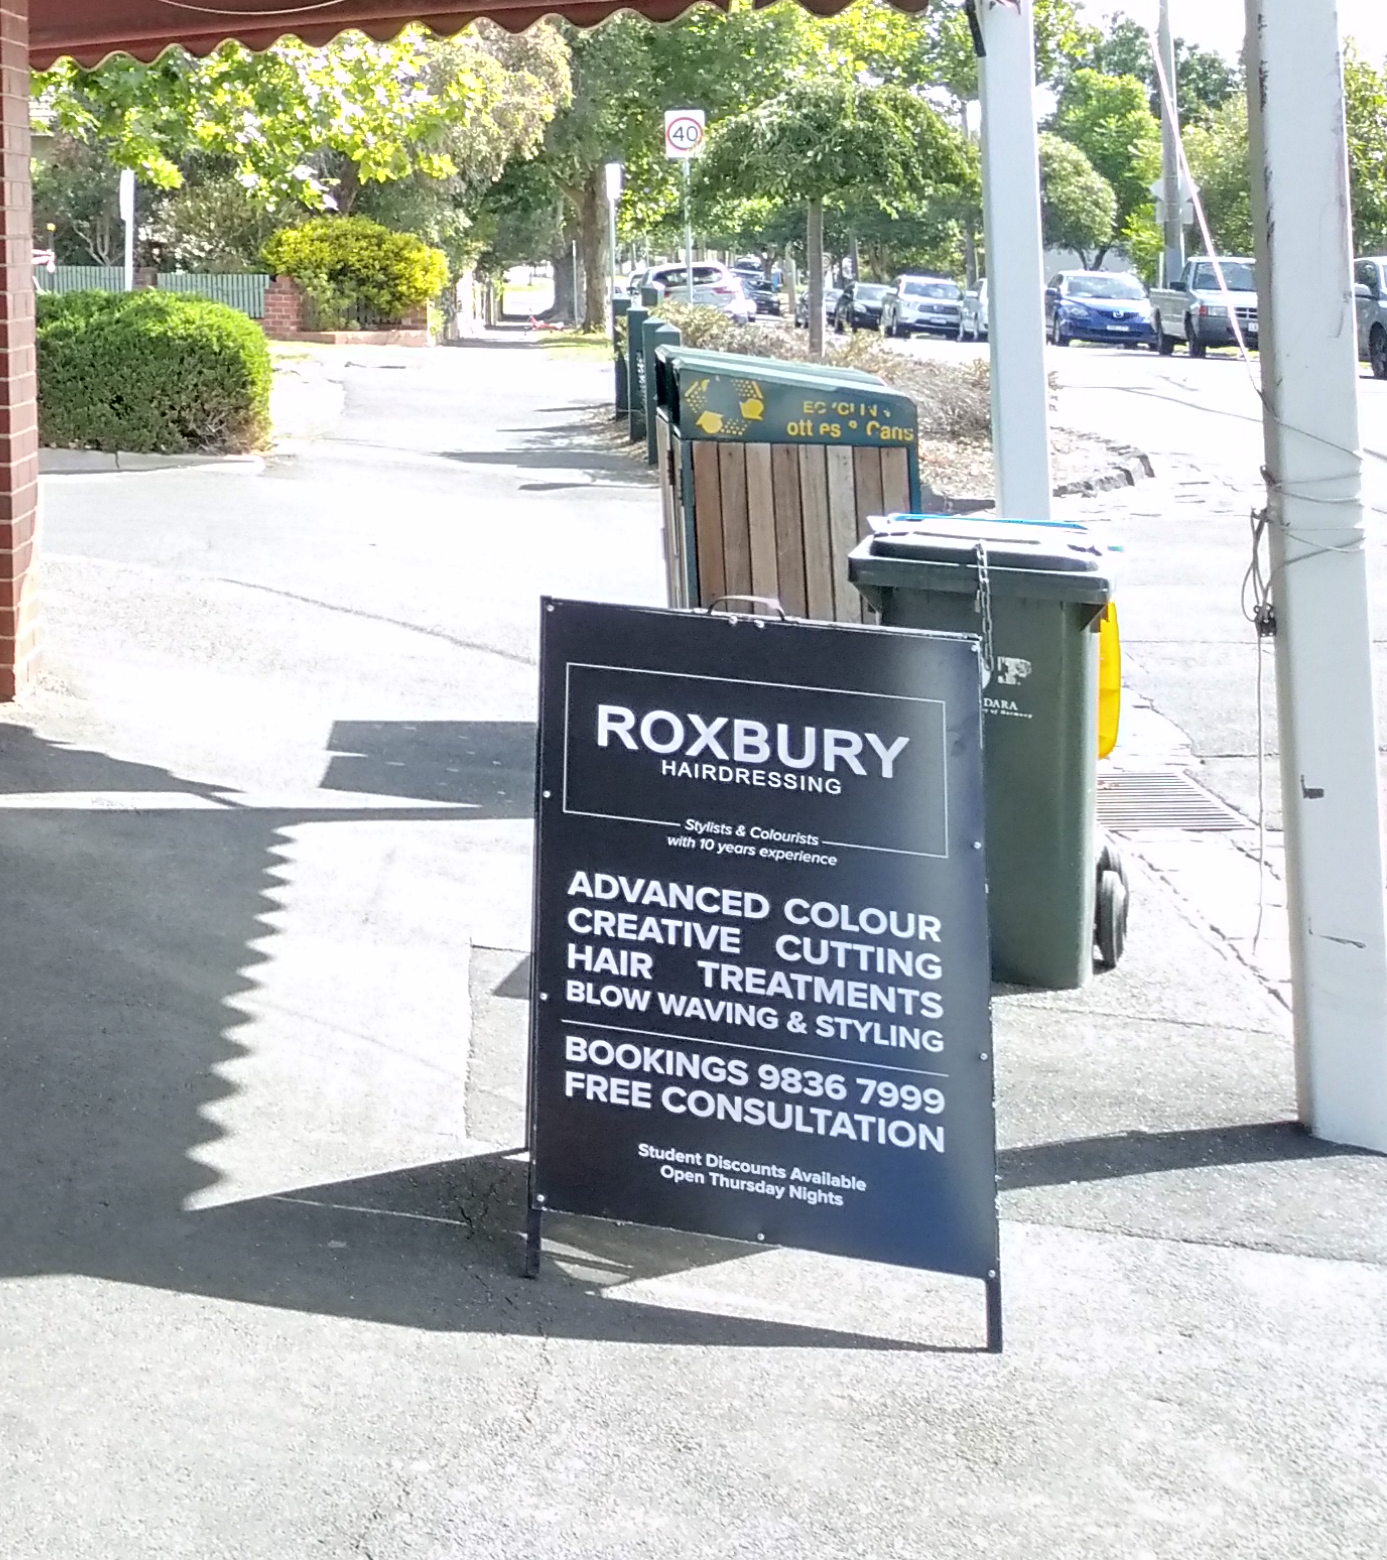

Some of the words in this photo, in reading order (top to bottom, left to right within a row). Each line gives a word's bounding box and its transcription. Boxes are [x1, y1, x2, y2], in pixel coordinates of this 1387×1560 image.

[672, 125, 699, 142] 40
[787, 419, 842, 438] ottes
[596, 704, 911, 779] ROXBURY
[660, 759, 842, 794] HAIRDRESSING
[666, 834, 696, 849] with
[699, 837, 715, 851] 10
[717, 841, 756, 858] years
[759, 845, 838, 867] experience
[684, 818, 732, 837] Stylists
[735, 825, 746, 837] &
[750, 826, 819, 846] Colourists
[567, 871, 770, 919] ADVANCED
[783, 898, 941, 942] COLOUR
[567, 907, 741, 954] CREATIVE
[776, 934, 942, 980] CUTTING
[567, 942, 653, 980] HAIR
[697, 960, 944, 1019] TREATMENTS
[566, 980, 651, 1011] BLOW
[657, 992, 778, 1030] WAVING
[786, 1011, 808, 1034] &
[815, 1015, 945, 1052] STYLING
[565, 1035, 748, 1086] BOOKINGS
[757, 1064, 847, 1100] 9836
[855, 1077, 945, 1115] 7999
[565, 1071, 651, 1108] FREE
[661, 1086, 945, 1153] CONSULTATION
[637, 1143, 702, 1166] Student
[705, 1153, 786, 1179] Discounts
[790, 1167, 867, 1191] Available
[660, 1165, 705, 1185] Open
[709, 1172, 785, 1199] Thursday
[789, 1183, 844, 1207] Nights
